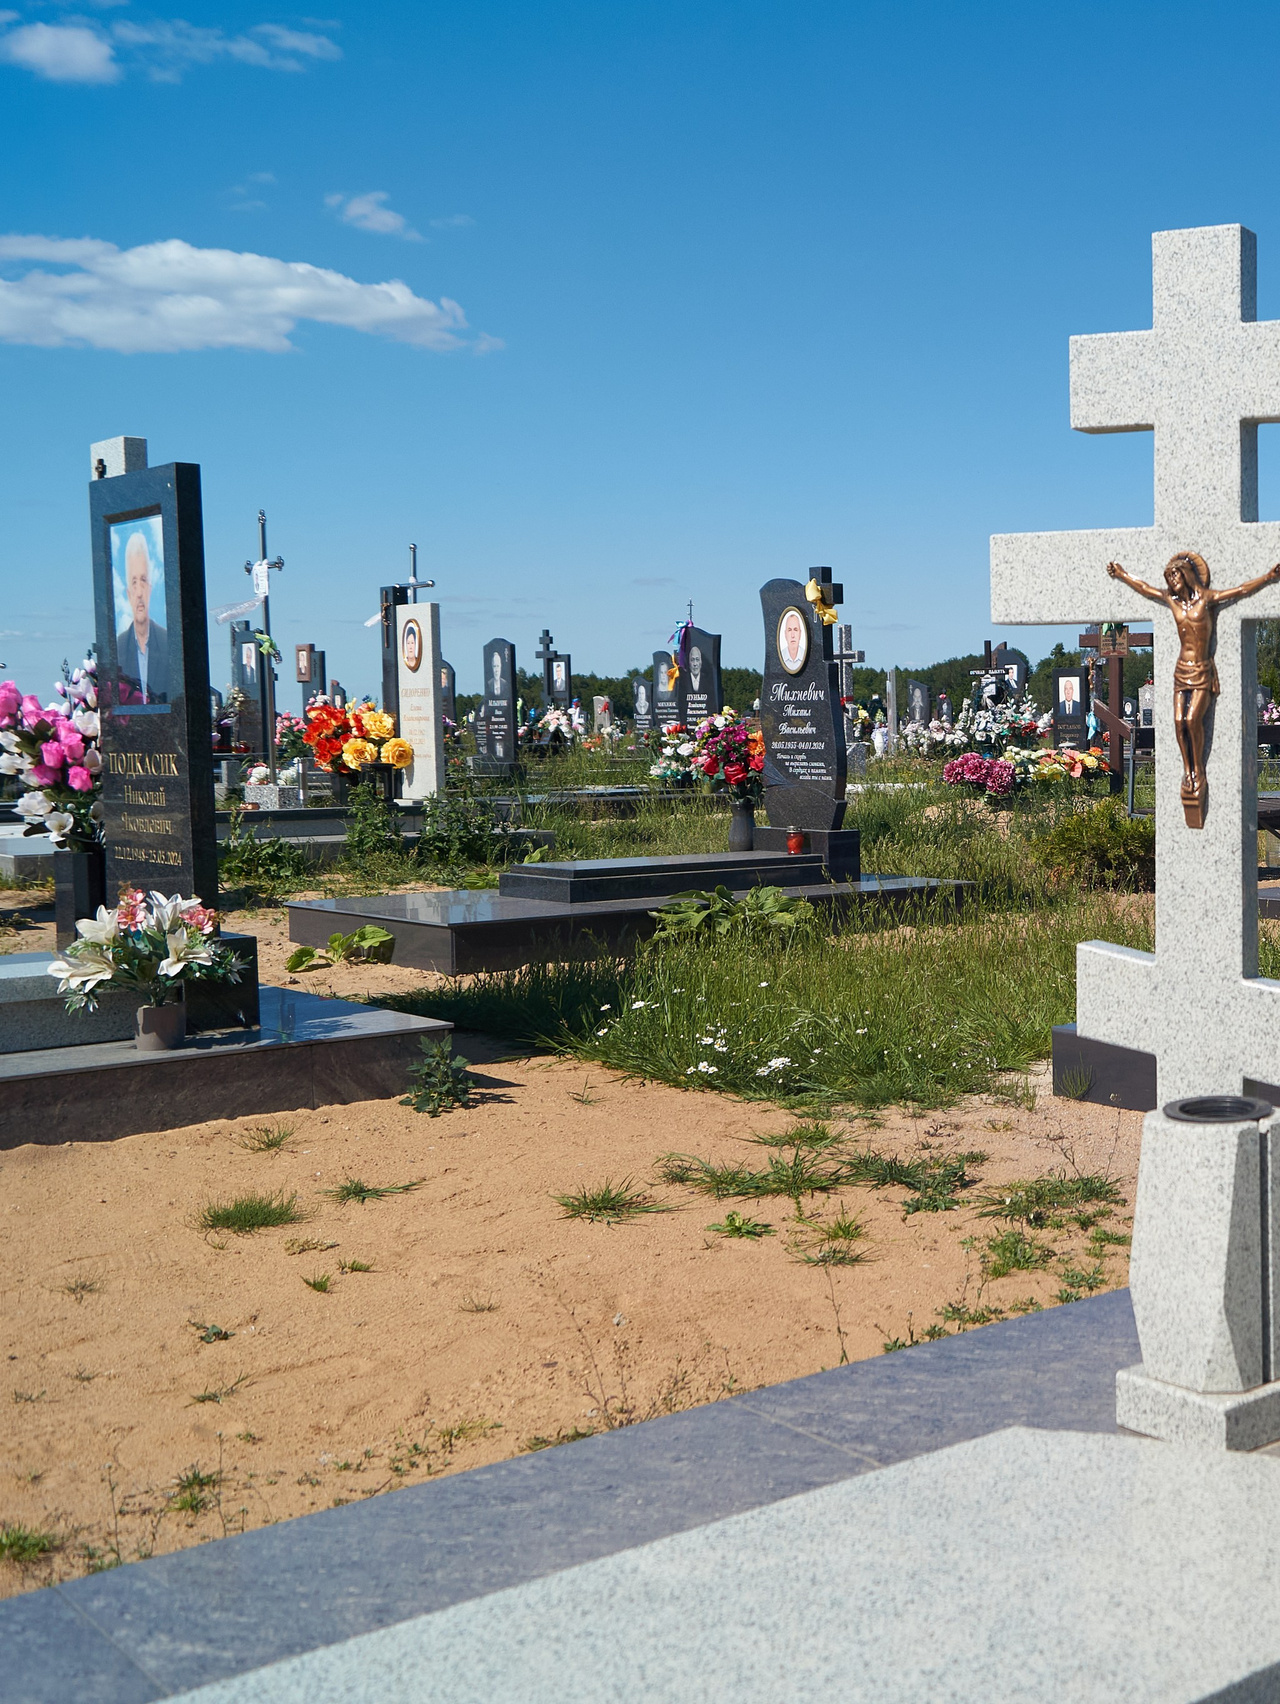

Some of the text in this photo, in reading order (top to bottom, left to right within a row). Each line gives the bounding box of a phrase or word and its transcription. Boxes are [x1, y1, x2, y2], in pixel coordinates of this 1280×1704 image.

[770, 681, 825, 701] Михневич
[782, 704, 812, 717] Михаил
[778, 721, 817, 735] Васильевич
[108, 752, 180, 779] ПОДКАСИК
[124, 785, 167, 807] Николай
[121, 812, 173, 835] Яковлевич
